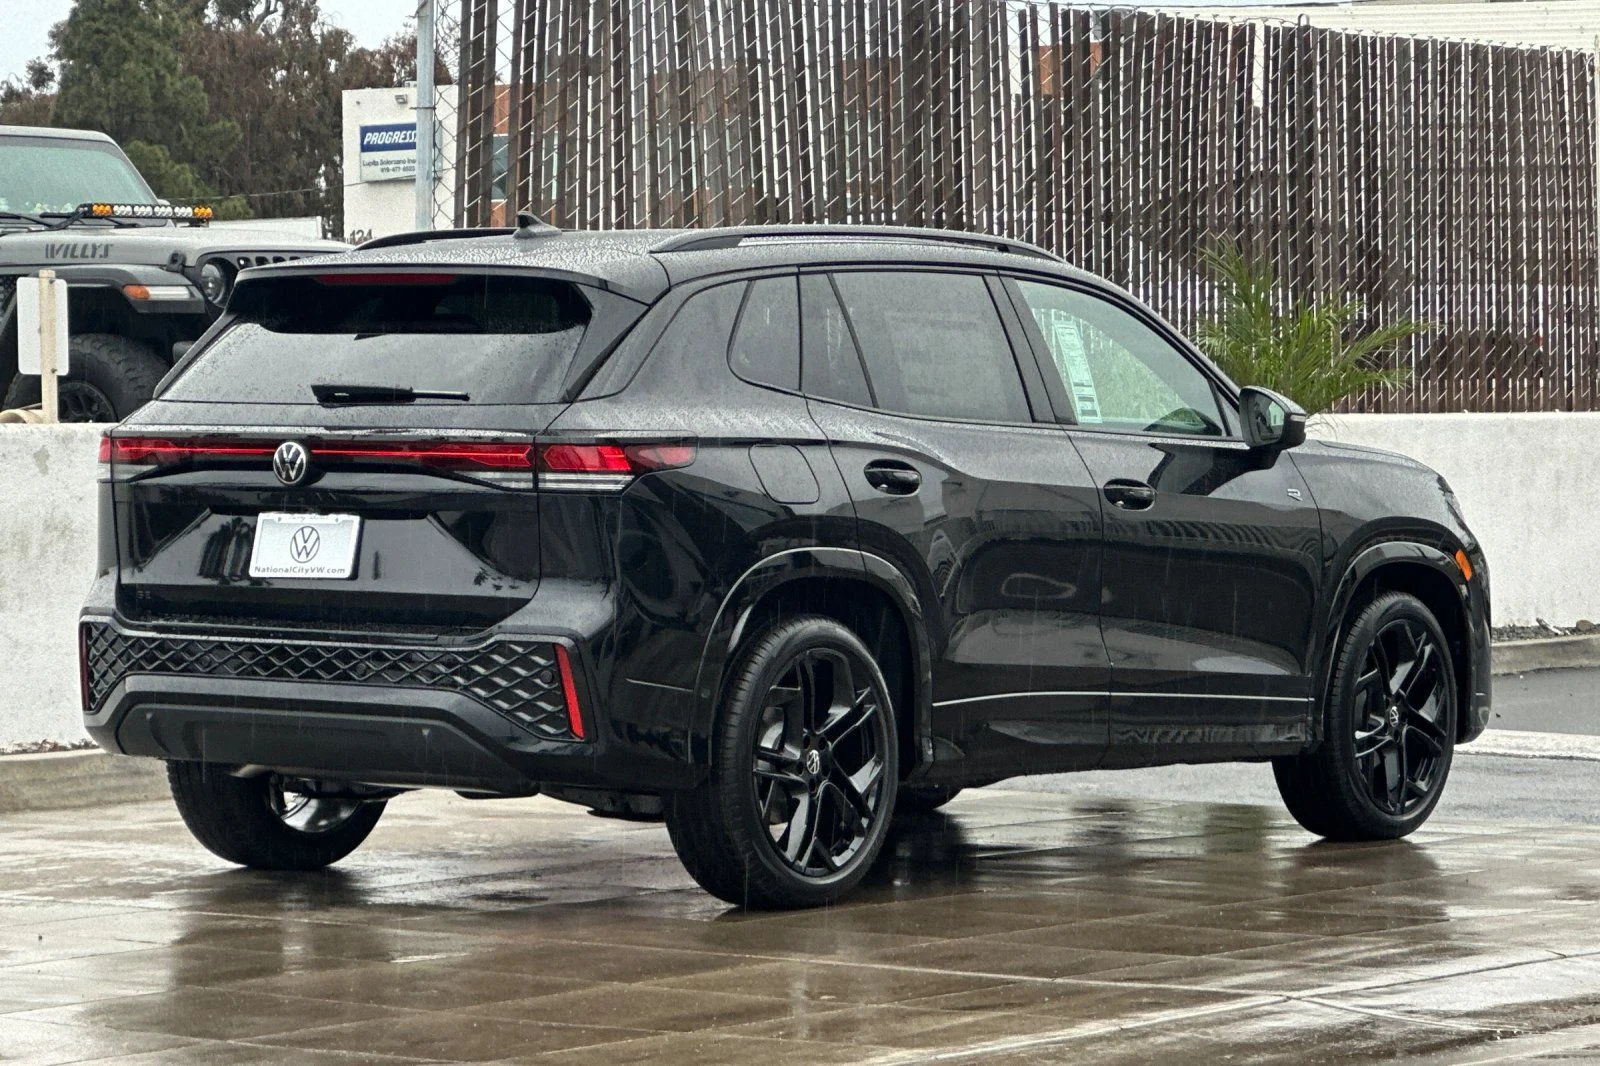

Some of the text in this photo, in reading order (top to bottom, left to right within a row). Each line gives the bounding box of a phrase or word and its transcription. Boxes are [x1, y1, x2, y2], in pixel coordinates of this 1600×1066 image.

[363, 130, 416, 145] PROGRESS
[45, 242, 114, 259] WILLYS
[254, 565, 346, 575] NationalCityVW.com
